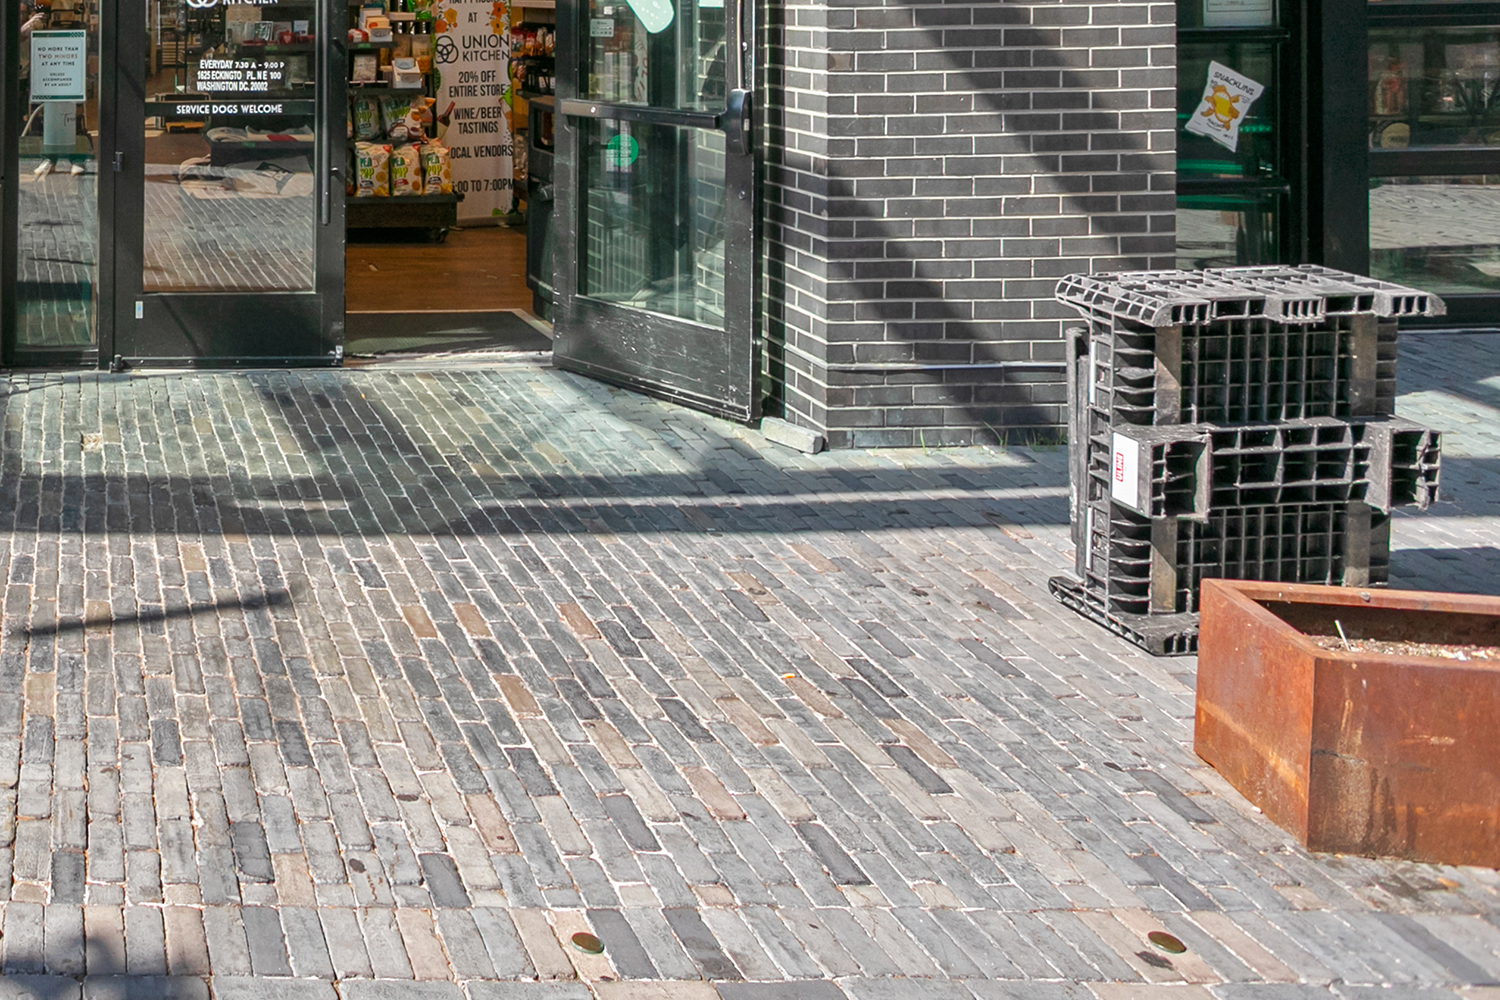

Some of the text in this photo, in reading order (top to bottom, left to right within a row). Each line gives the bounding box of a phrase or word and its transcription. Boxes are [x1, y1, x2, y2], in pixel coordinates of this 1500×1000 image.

[468, 12, 478, 23] AT
[462, 34, 510, 49] UNION
[462, 50, 511, 62] KITCHEN
[200, 60, 234, 69] EVERYDAY
[197, 70, 211, 80] 1625
[269, 72, 282, 80] 100
[458, 70, 496, 83] 20% OFF
[196, 81, 238, 91] WASHINGTON
[250, 81, 268, 91] 20002
[1213, 71, 1255, 96] SNACKLINS
[449, 84, 505, 98] ENTIRE STORE
[176, 104, 283, 114] SERVICE DOGS WELCOME
[454, 106, 502, 120] WINE/BEER
[458, 121, 499, 134] TASTINGS
[449, 145, 514, 159] OCAL VENDORS
[470, 180, 483, 192] TO
[1116, 453, 1124, 482] ULINE
